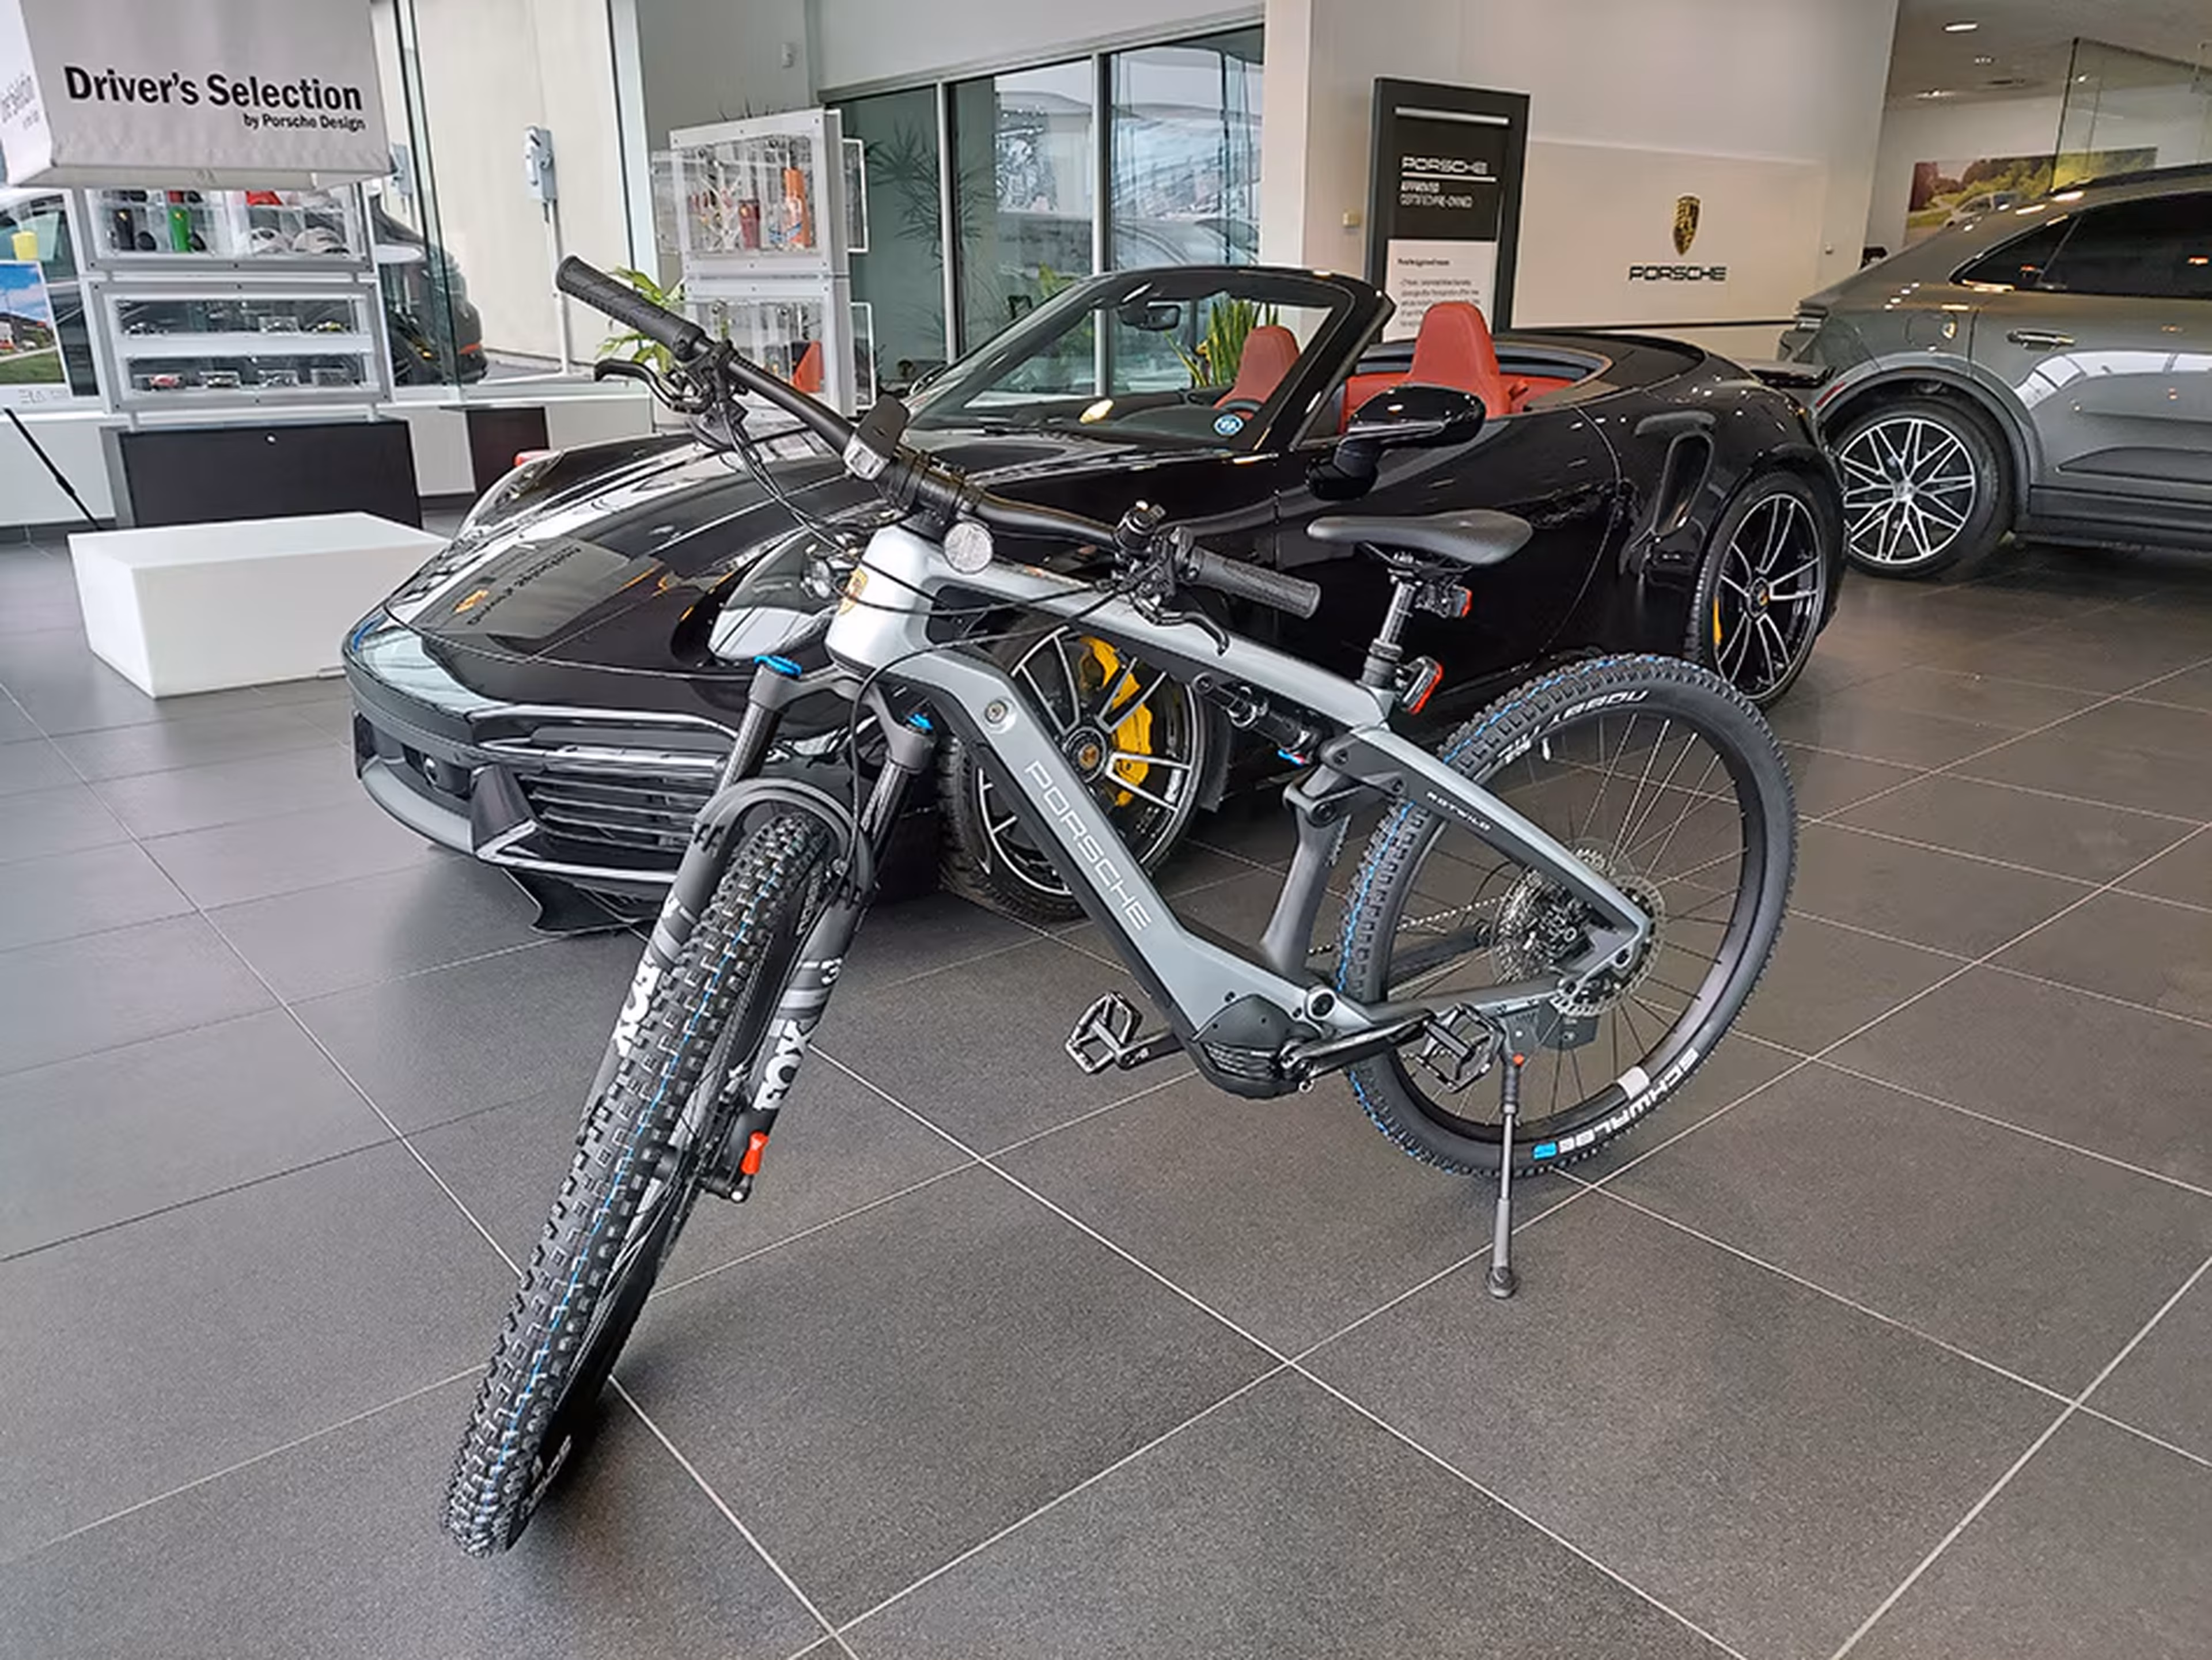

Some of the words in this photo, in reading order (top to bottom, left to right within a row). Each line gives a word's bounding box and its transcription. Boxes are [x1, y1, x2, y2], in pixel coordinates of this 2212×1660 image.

[64, 66, 199, 105] Driver's
[207, 74, 362, 110] Selection
[244, 113, 260, 128] by
[320, 116, 366, 132] Design
[1629, 266, 1726, 281] PORSCHE
[1024, 761, 1153, 931] PORSCHE
[751, 1019, 809, 1111] FOX
[1558, 1046, 1699, 1154] SCHWALBE
